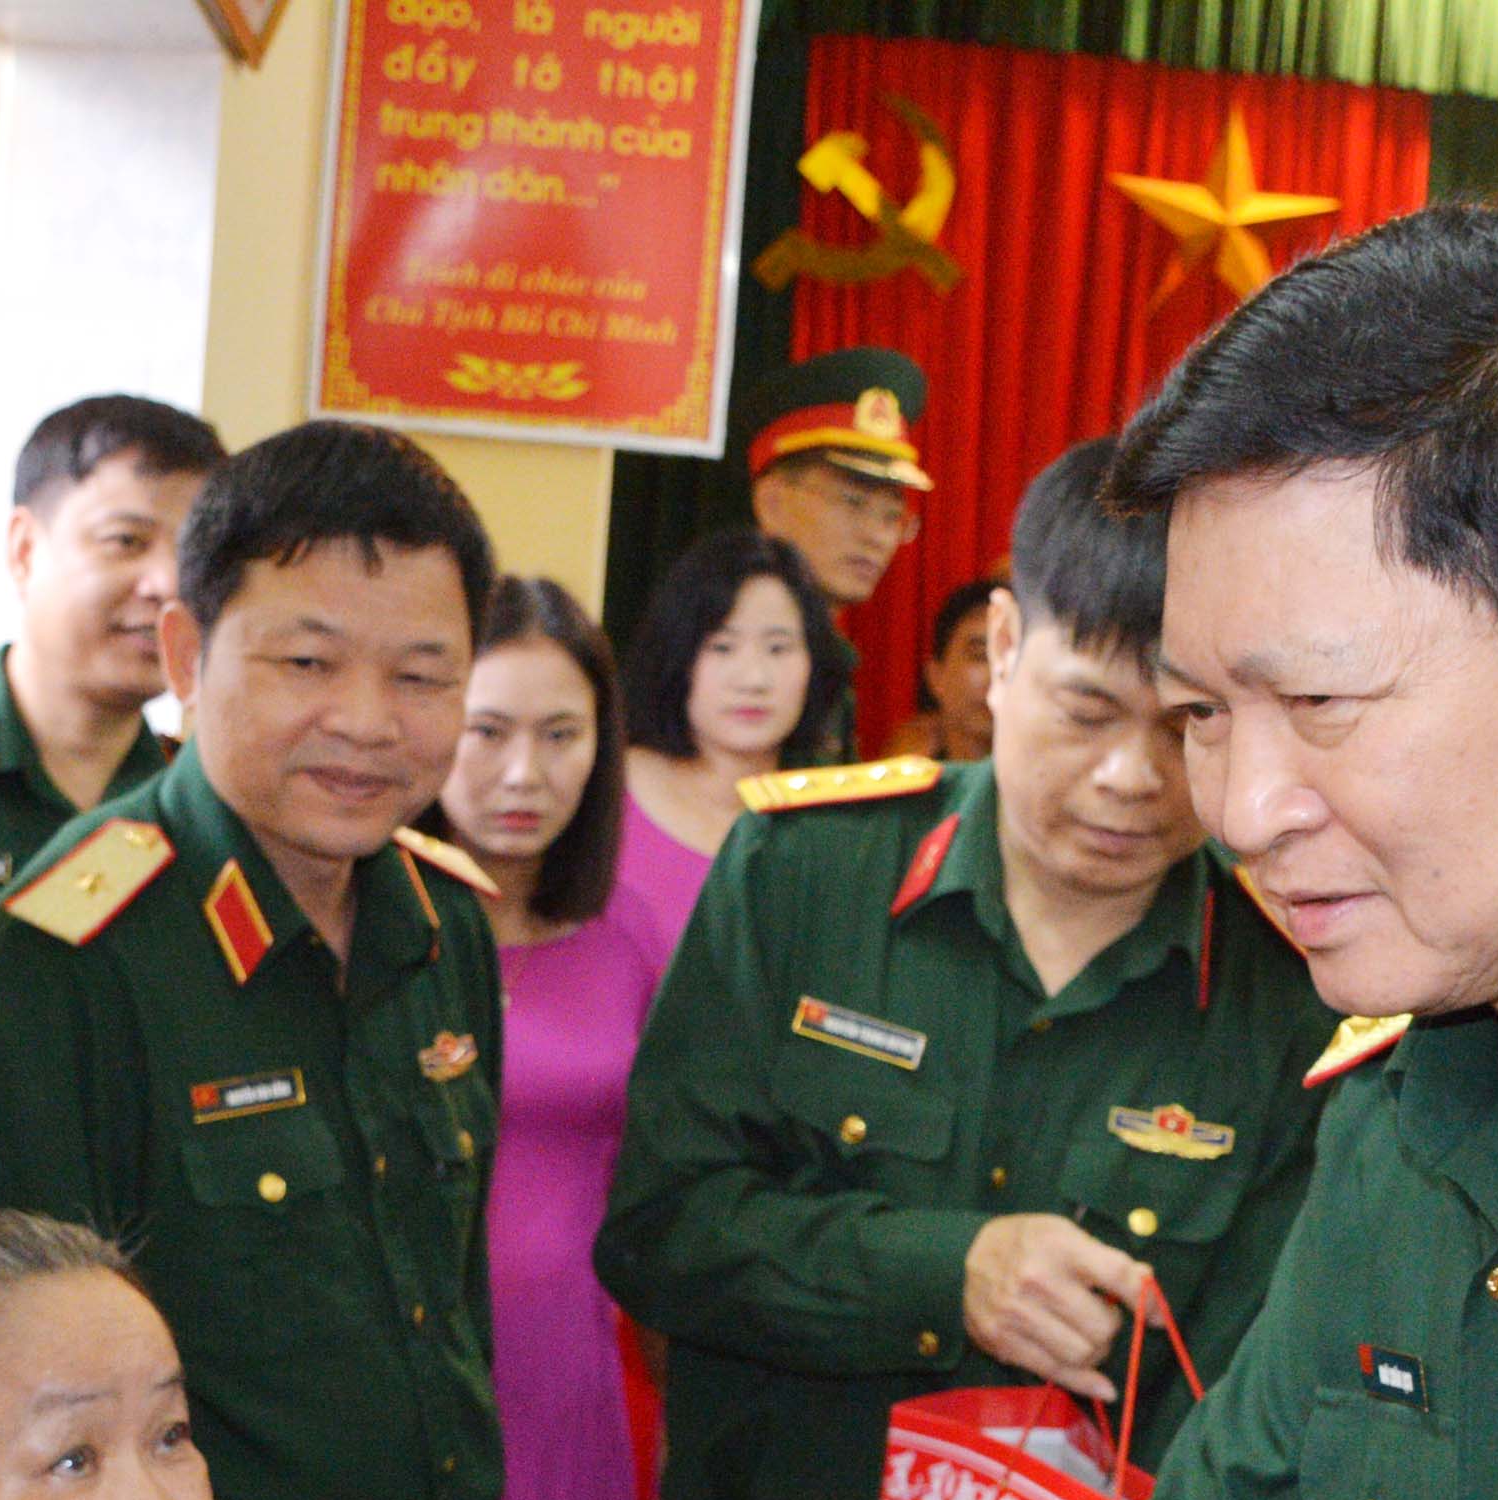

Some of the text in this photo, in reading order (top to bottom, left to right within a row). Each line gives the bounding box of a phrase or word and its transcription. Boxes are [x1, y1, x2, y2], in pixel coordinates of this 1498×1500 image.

[584, 5, 701, 51] người
[379, 102, 693, 158] trung thành của
[374, 160, 479, 197] nhân
